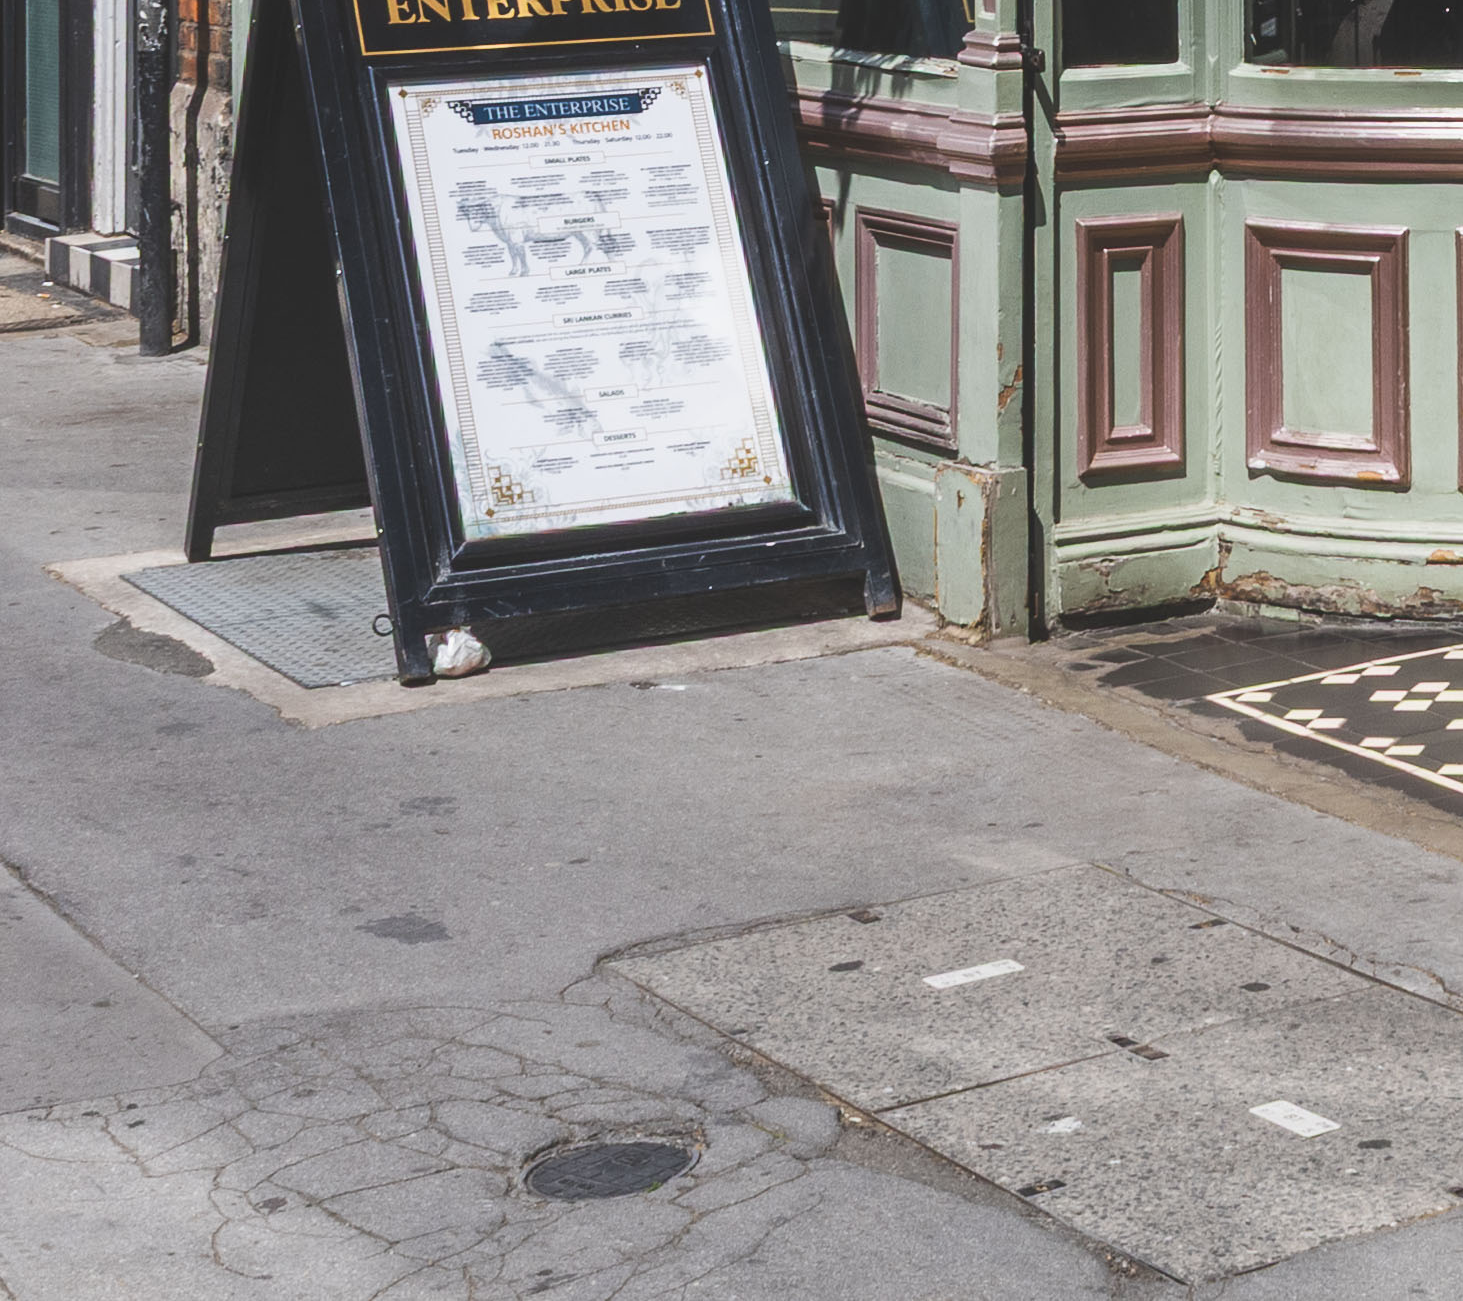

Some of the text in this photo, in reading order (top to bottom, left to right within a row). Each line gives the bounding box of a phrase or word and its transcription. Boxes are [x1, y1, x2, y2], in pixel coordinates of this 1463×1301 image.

[483, 97, 632, 121] THE ENTERPRISE
[491, 119, 631, 140] ROSHAN'S KITCHEN
